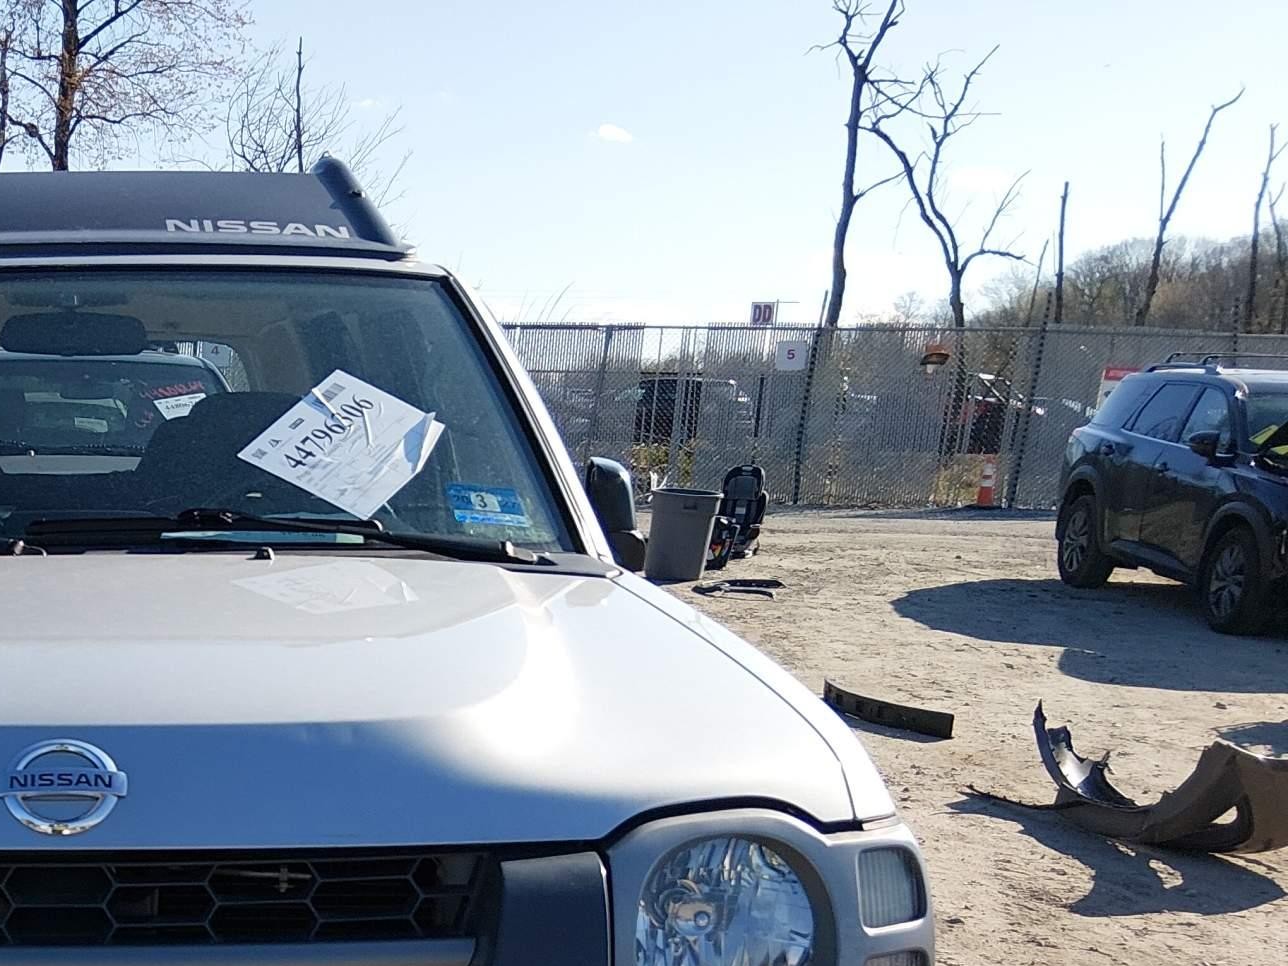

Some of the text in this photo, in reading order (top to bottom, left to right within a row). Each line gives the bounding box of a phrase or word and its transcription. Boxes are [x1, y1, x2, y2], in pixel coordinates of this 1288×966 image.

[165, 219, 350, 239] NISSAN
[753, 304, 773, 323] DD
[211, 345, 220, 356] 4
[786, 349, 796, 360] 5
[284, 393, 374, 469] 44796306
[475, 494, 488, 509] 3
[9, 773, 112, 789] NISSAN
